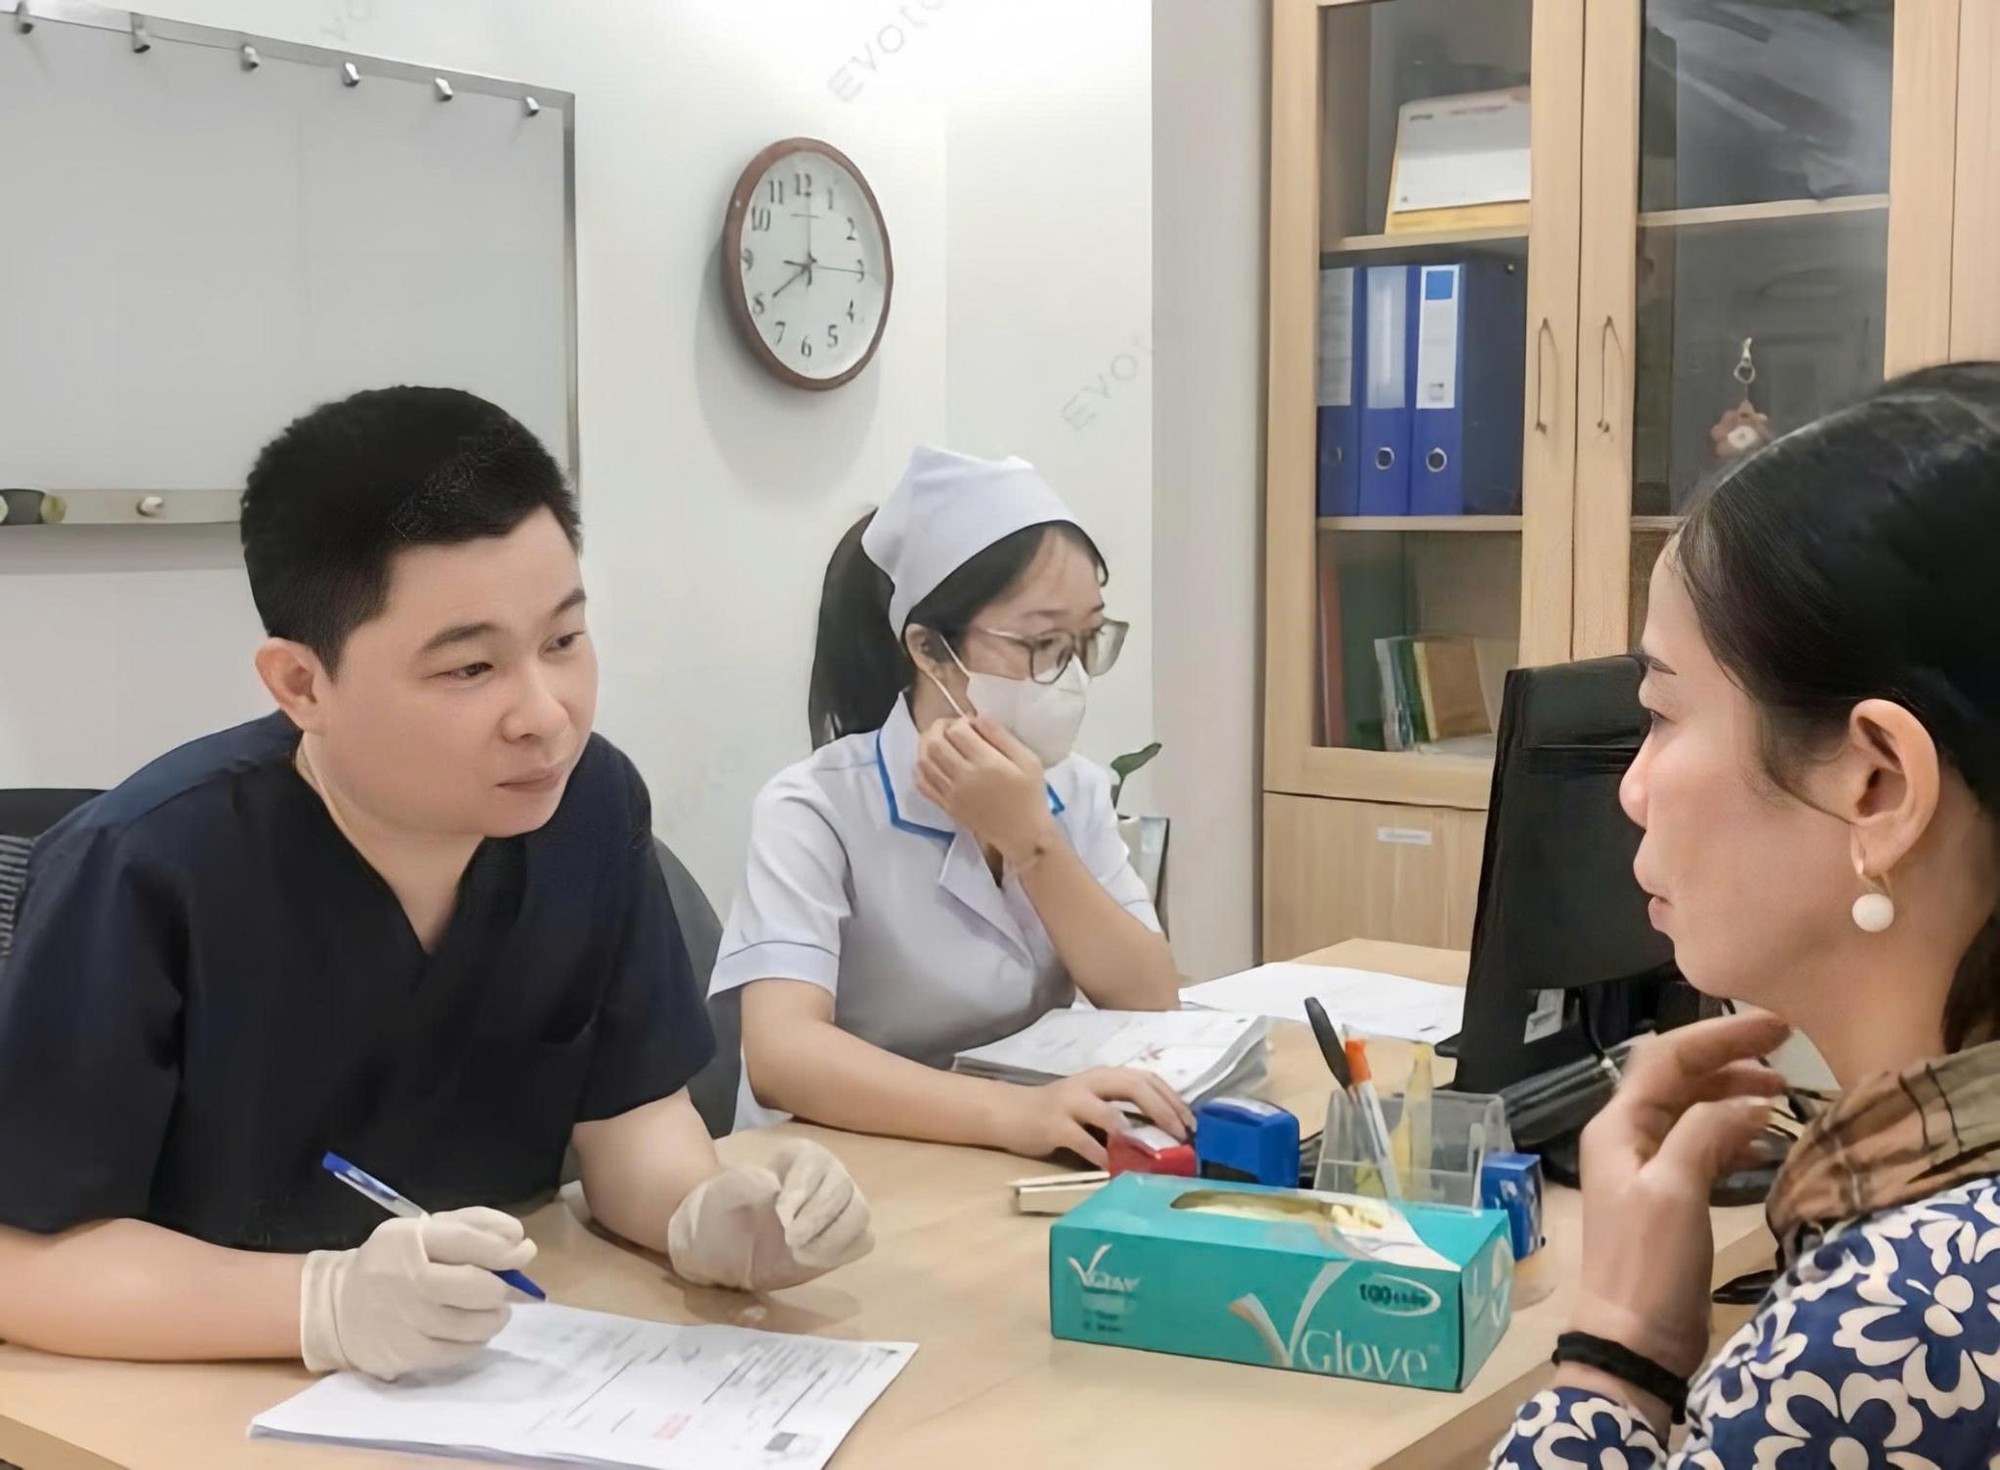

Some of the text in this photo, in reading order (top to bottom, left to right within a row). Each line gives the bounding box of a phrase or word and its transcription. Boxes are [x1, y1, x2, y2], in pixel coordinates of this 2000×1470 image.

[769, 180, 784, 205] 11
[795, 173, 812, 198] 12
[751, 205, 772, 232] 10
[846, 217, 857, 241] 2
[773, 320, 786, 345] 7
[826, 323, 839, 348] 5
[800, 334, 813, 358] 6
